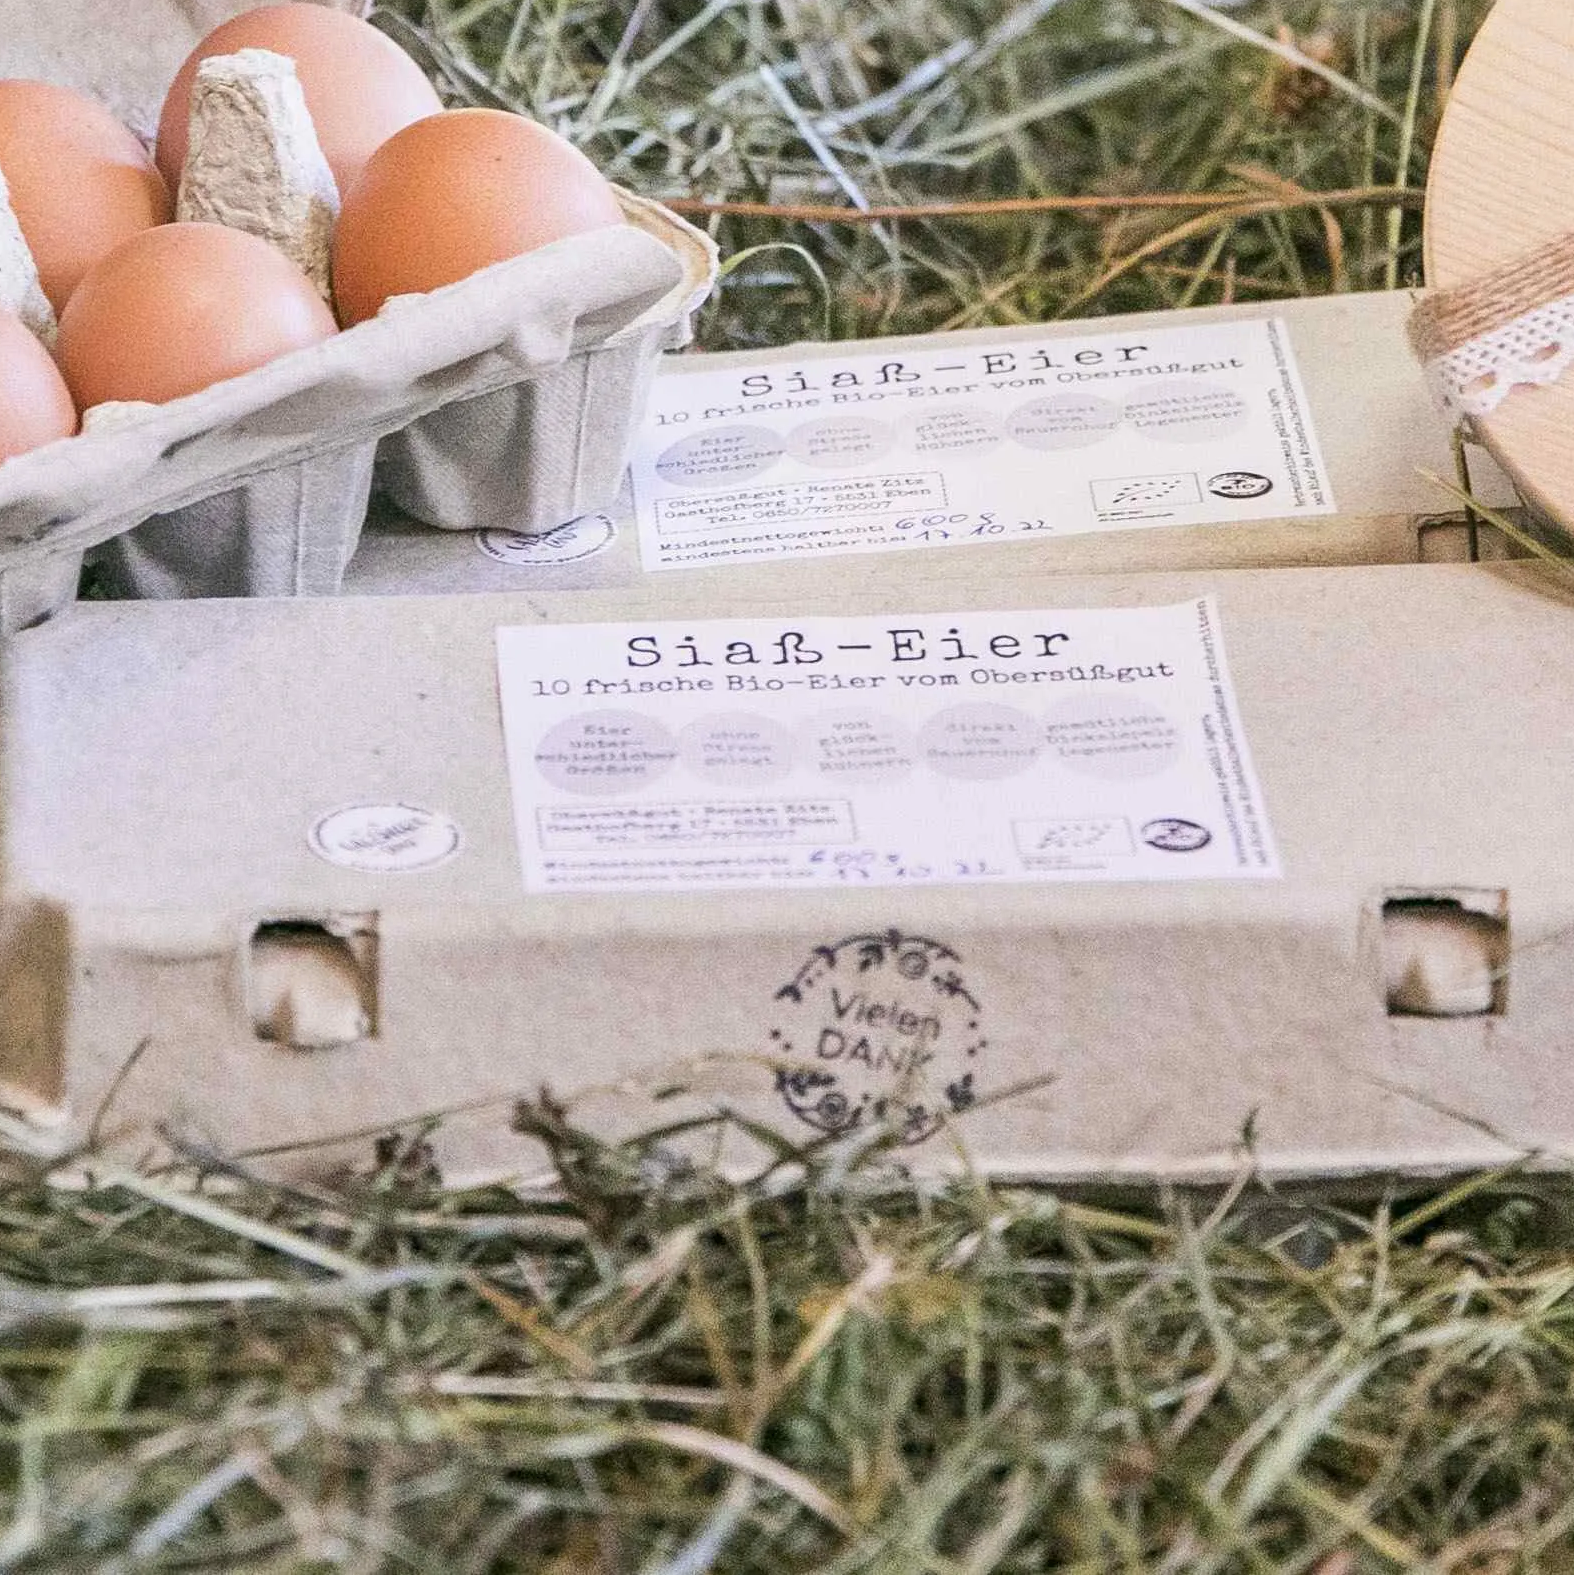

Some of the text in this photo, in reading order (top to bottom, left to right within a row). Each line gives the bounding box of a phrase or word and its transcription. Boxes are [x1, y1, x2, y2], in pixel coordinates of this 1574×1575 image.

[657, 355, 1245, 426] 10 frische Bio-Eier vom Obersüßgut
[742, 344, 1148, 397] Siaß-Eier
[700, 435, 746, 446] Eier
[885, 487, 931, 499] Eben
[626, 627, 1071, 668] Siaß-Eier
[532, 661, 1175, 697] 10 frische Bio-Eier vom Obersüßgut
[830, 987, 942, 1041] Vielen
